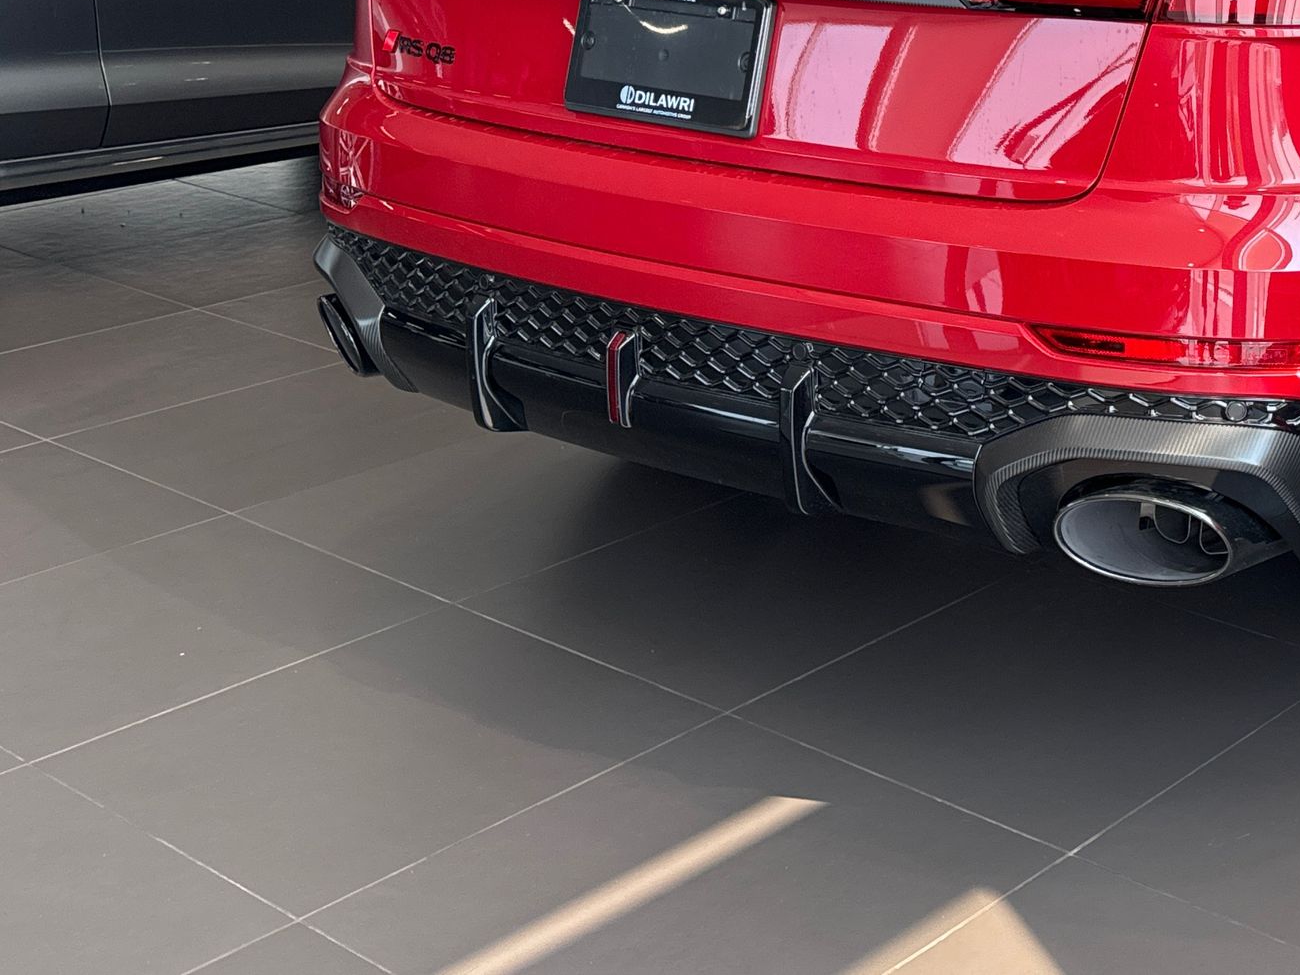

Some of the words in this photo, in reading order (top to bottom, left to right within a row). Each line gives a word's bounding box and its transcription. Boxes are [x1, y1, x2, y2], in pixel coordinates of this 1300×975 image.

[399, 36, 424, 57] RS
[425, 42, 456, 65] Q8
[634, 89, 695, 112] DILAWRI
